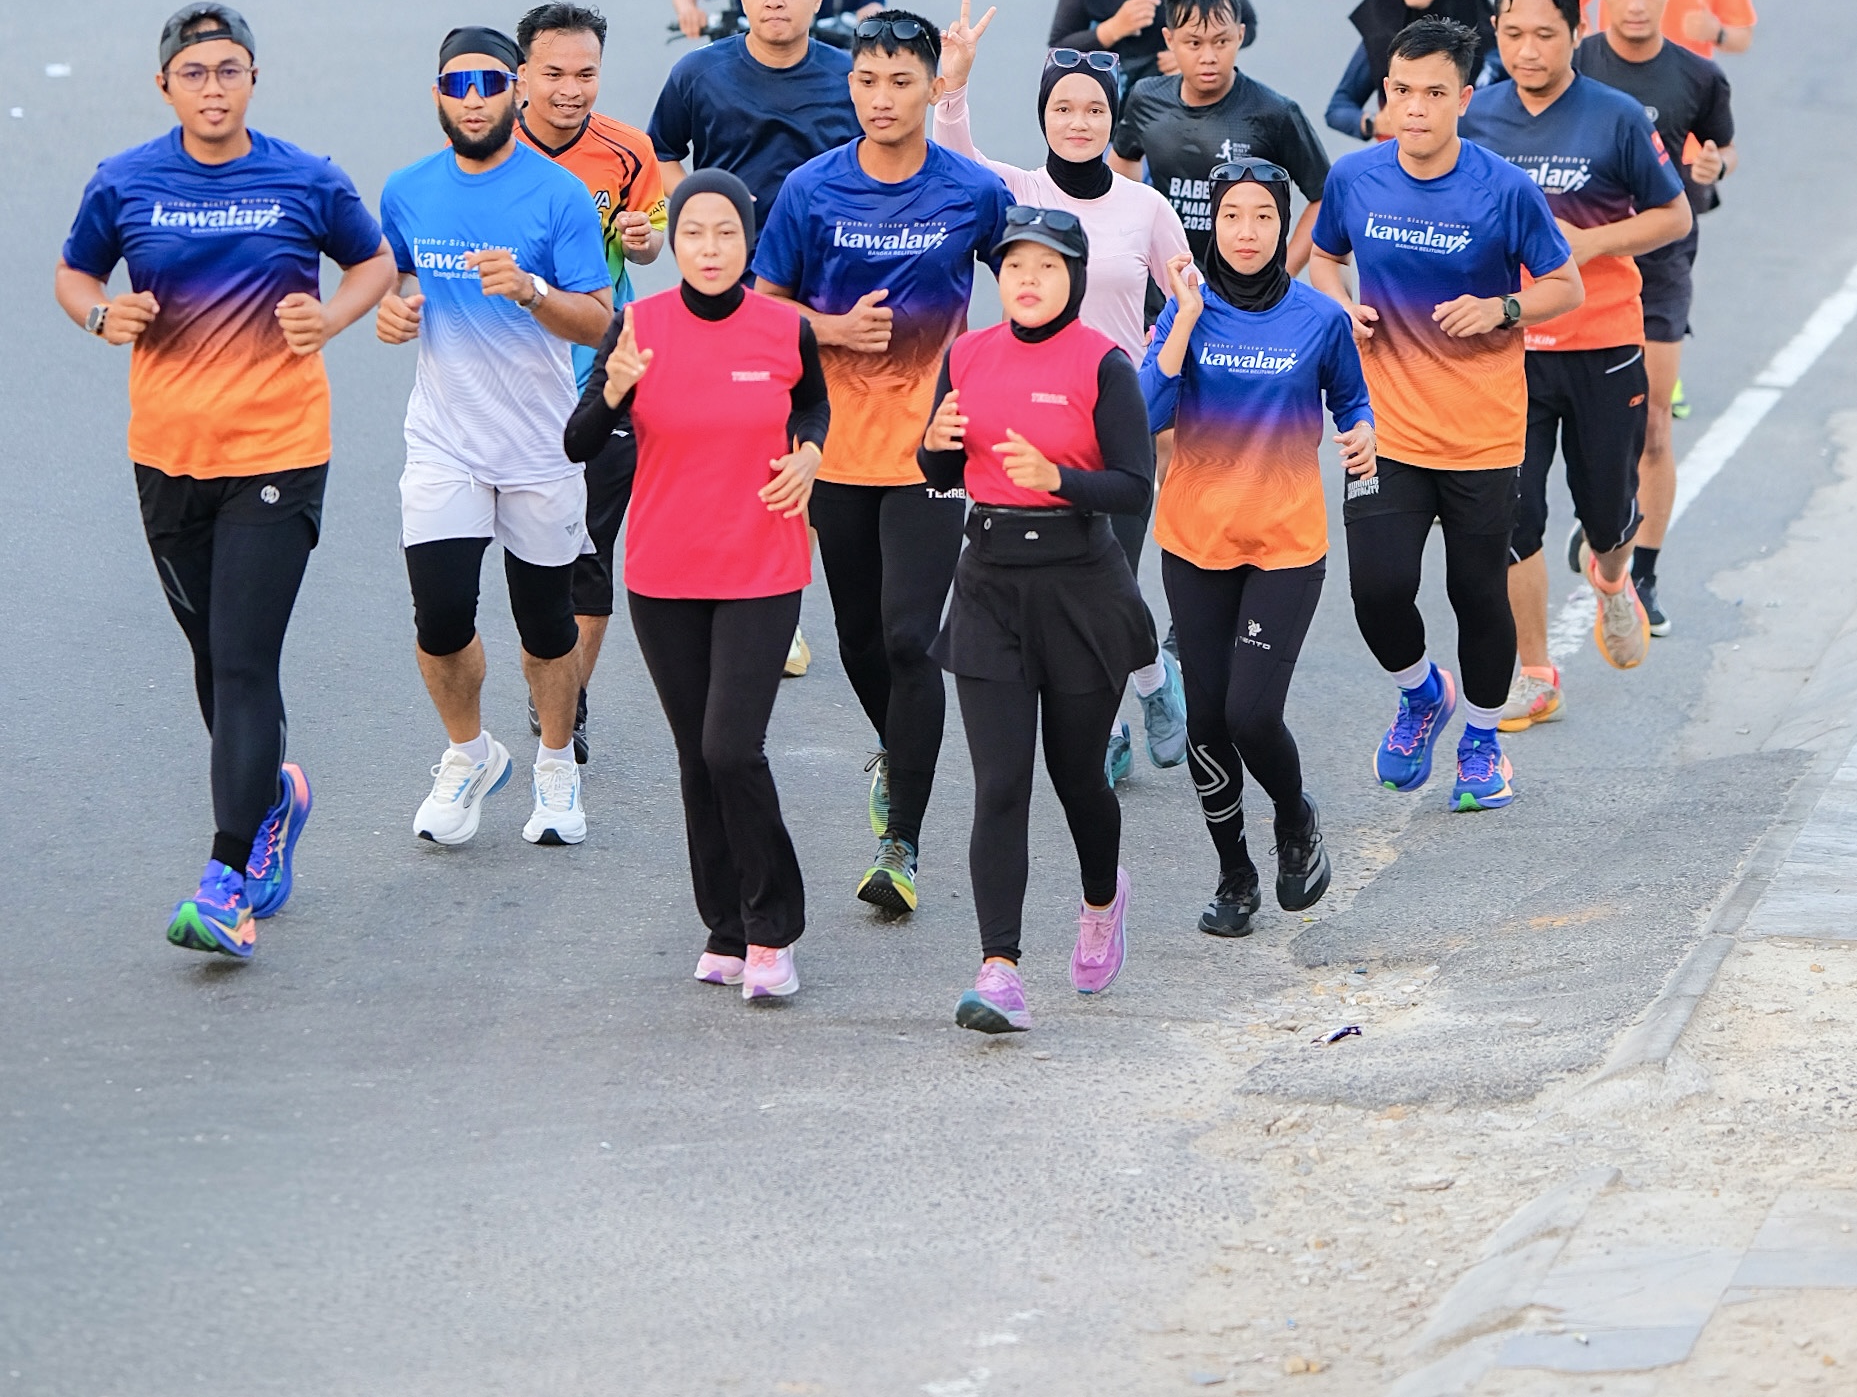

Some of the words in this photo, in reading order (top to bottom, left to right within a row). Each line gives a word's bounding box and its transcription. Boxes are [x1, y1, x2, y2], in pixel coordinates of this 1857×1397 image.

[1518, 155, 1549, 163] Sister
[1551, 155, 1591, 164] Runner
[1169, 177, 1211, 200] BABE
[1181, 200, 1212, 216] MARA
[1184, 216, 1212, 231] 2026
[1368, 212, 1403, 221] Brother
[1406, 217, 1434, 226] Sister
[413, 237, 447, 245] Brother
[448, 239, 481, 249] Sister
